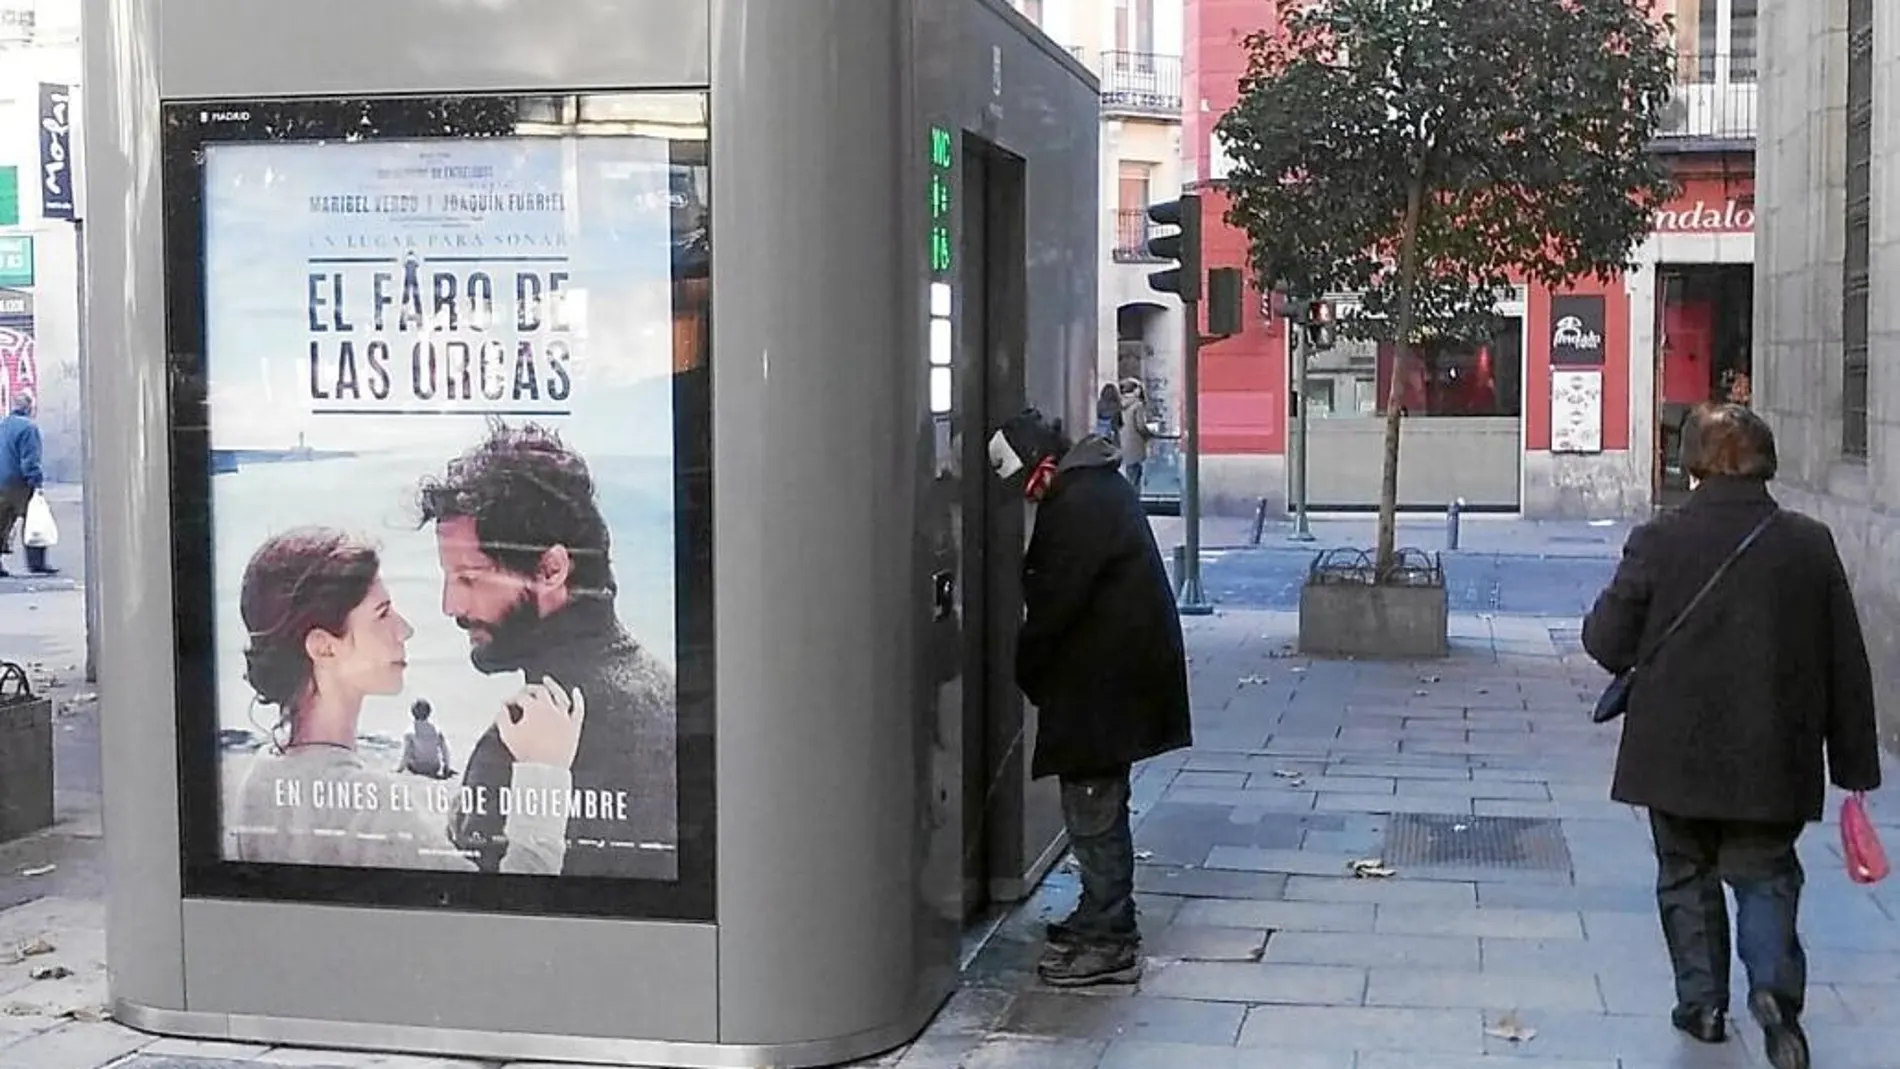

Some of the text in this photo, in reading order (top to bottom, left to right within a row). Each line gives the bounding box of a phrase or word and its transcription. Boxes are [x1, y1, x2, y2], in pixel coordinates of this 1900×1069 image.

[211, 111, 251, 121] MADRID
[932, 126, 950, 167] WC
[309, 194, 369, 212] MARIBEL
[508, 192, 566, 212] FURRIEL
[1653, 200, 1755, 229] ndalo
[427, 233, 485, 248] PARA
[309, 262, 570, 332] EL FARO DE
[310, 340, 571, 401] LAS ORCAS
[275, 778, 628, 820] EN CINES EL 16 DE DICIEMBRE
